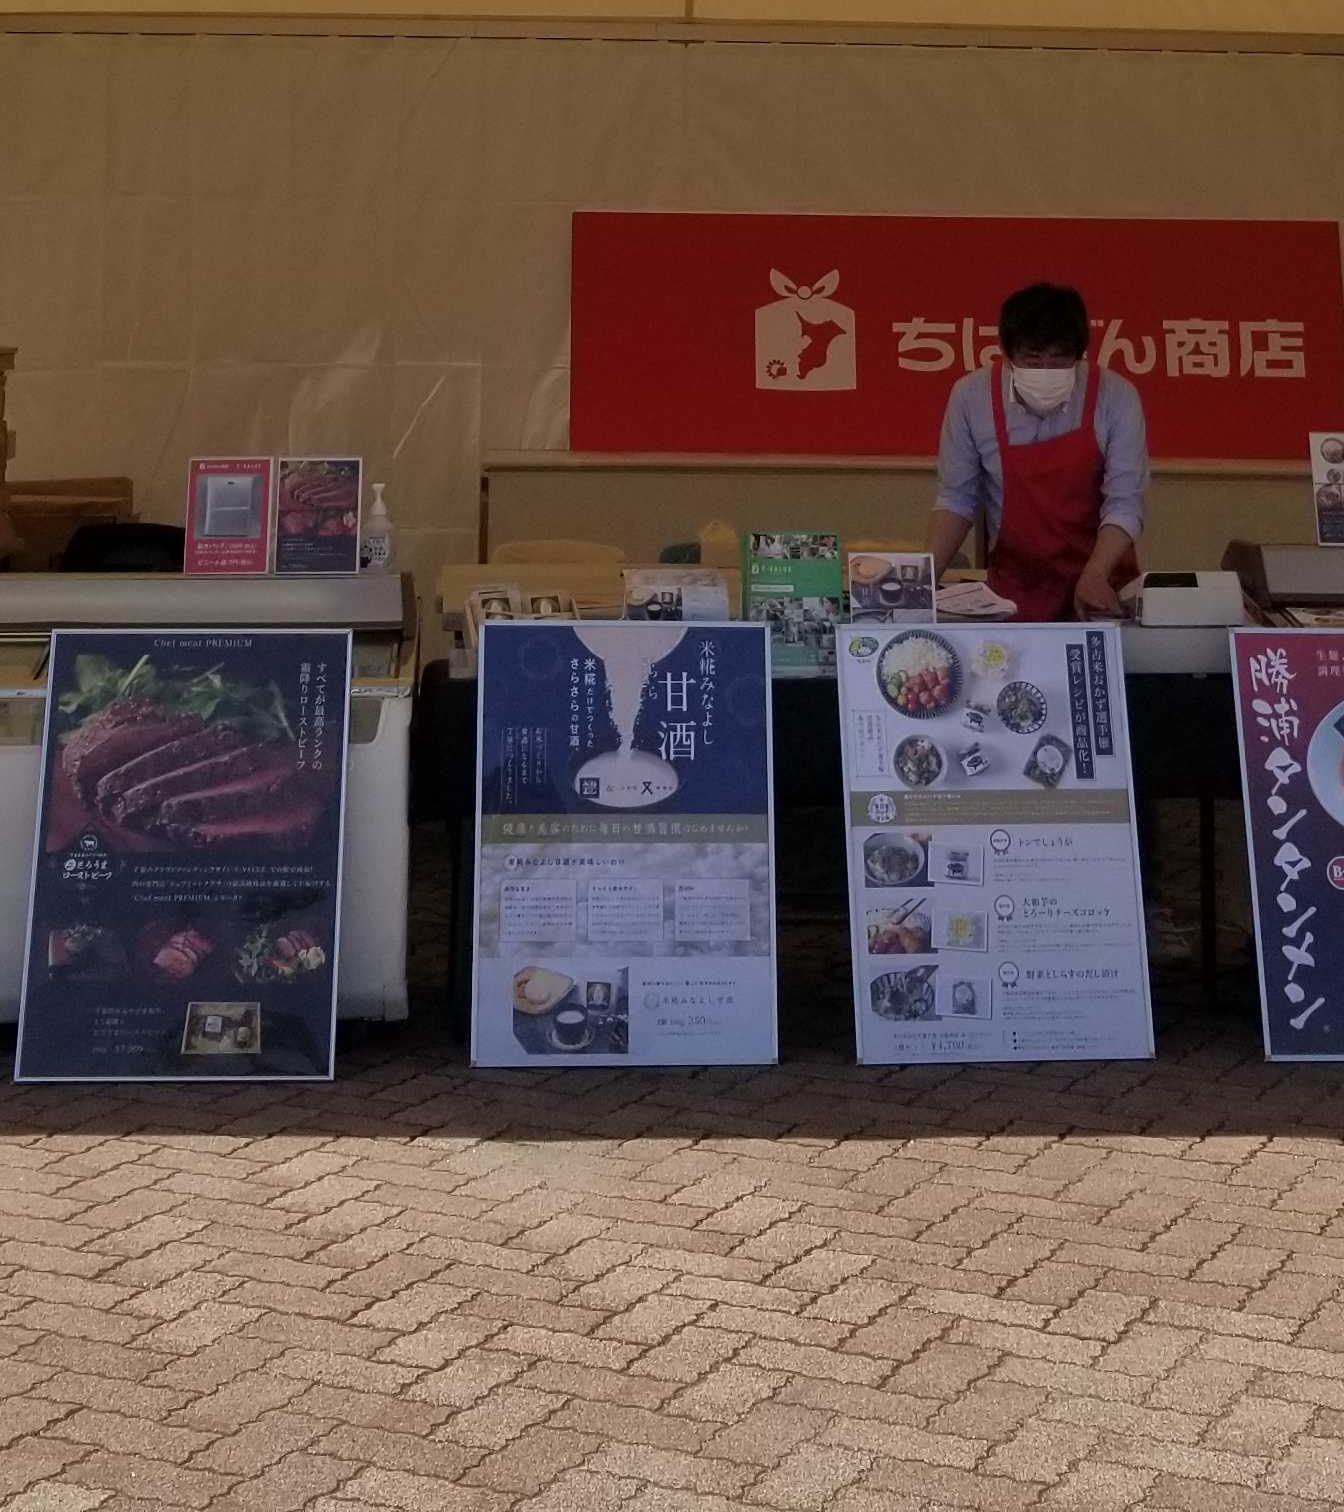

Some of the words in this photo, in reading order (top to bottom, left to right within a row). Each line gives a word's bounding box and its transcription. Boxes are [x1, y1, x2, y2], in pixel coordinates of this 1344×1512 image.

[206, 639, 253, 649] PREMIUM
[657, 671, 697, 761] 甘酒
[1249, 647, 1325, 1030] 勝浦タンタンメン
